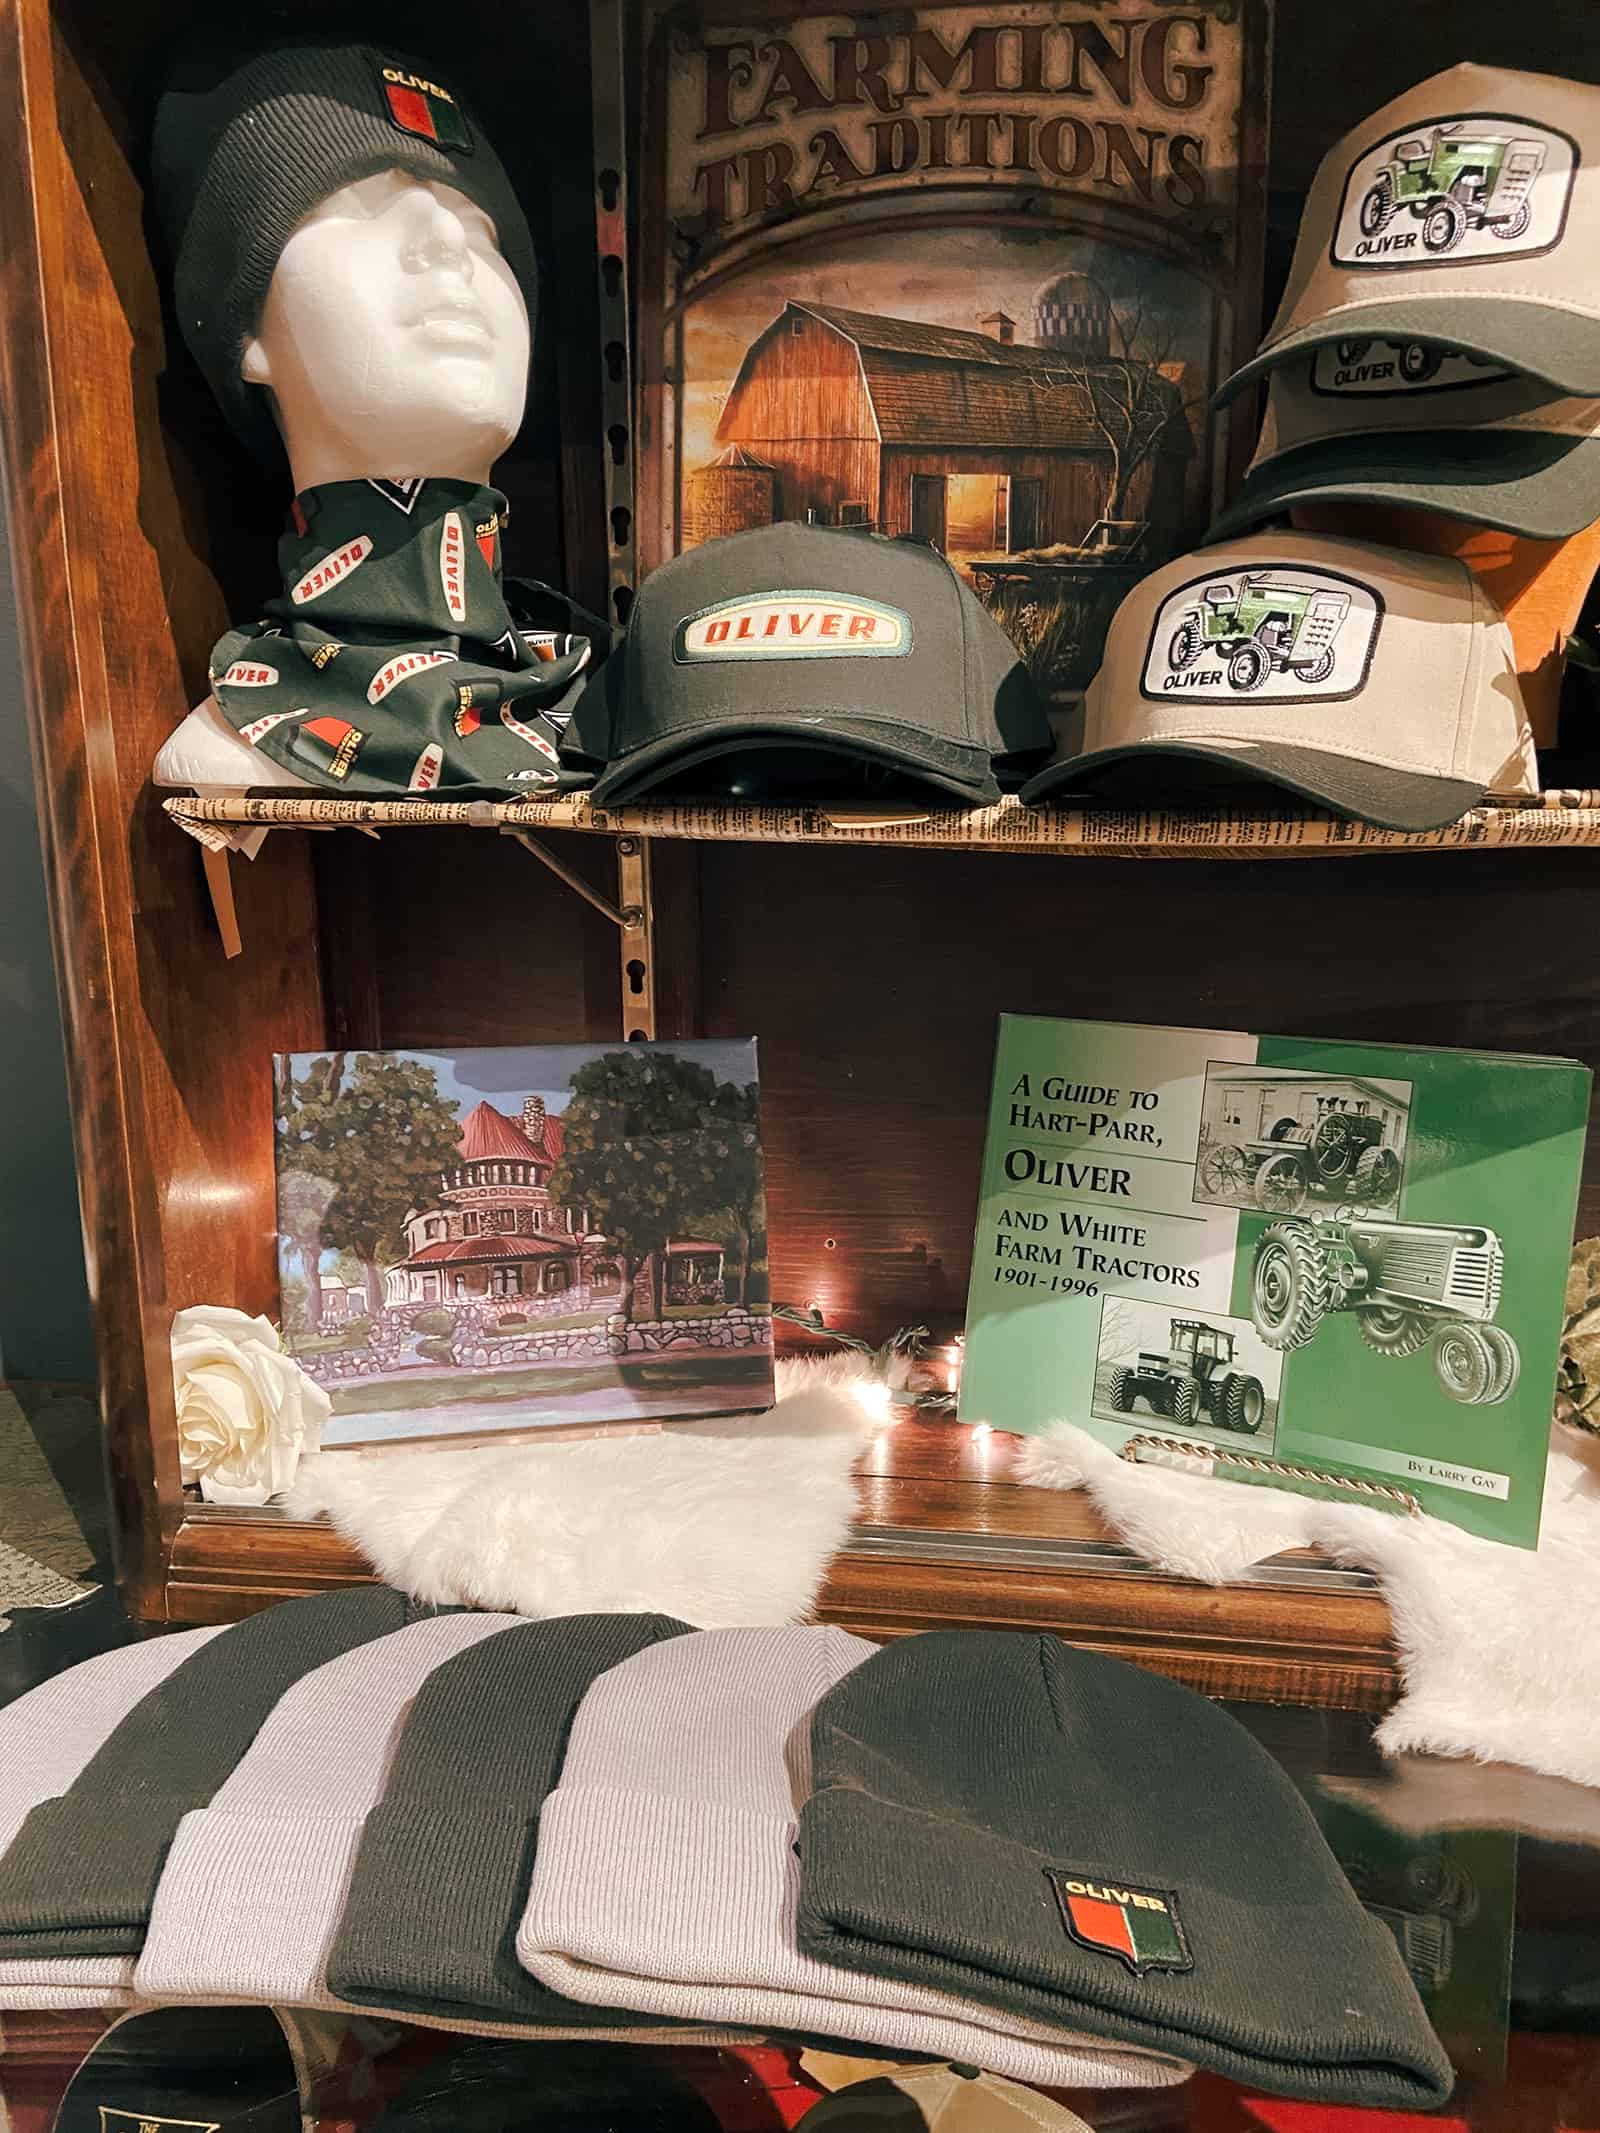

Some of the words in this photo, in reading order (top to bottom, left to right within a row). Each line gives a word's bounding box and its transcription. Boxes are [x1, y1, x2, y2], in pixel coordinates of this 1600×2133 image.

[382, 68, 454, 104] OLIVER
[696, 16, 1213, 140] FARMING
[693, 113, 1205, 223] TRADITIONS
[1355, 232, 1417, 257] OLIVER
[1334, 361, 1395, 386] OLIVER
[300, 544, 363, 599] OLIVER
[446, 526, 461, 609] OLIVER
[704, 613, 877, 646] OLIVER
[1163, 671, 1224, 691] OLIVER
[333, 731, 363, 778] OLIVER
[1011, 1074, 1031, 1097] A
[1042, 1077, 1120, 1107] GUIDE
[1129, 1090, 1160, 1111] TO
[1009, 1103, 1163, 1149] HART-PARR,
[1004, 1149, 1132, 1196] OLIVER
[997, 1209, 1049, 1233] AND
[1059, 1212, 1147, 1248] WHITE
[994, 1234, 1062, 1266] FARM
[1072, 1246, 1201, 1289] TRACTORS
[993, 1266, 1099, 1298] 1901-1996
[1408, 1460, 1424, 1473] BY
[1429, 1465, 1466, 1483] LARRY
[1471, 1475, 1497, 1489] GAY
[1065, 1880, 1168, 1913] OLIVER
